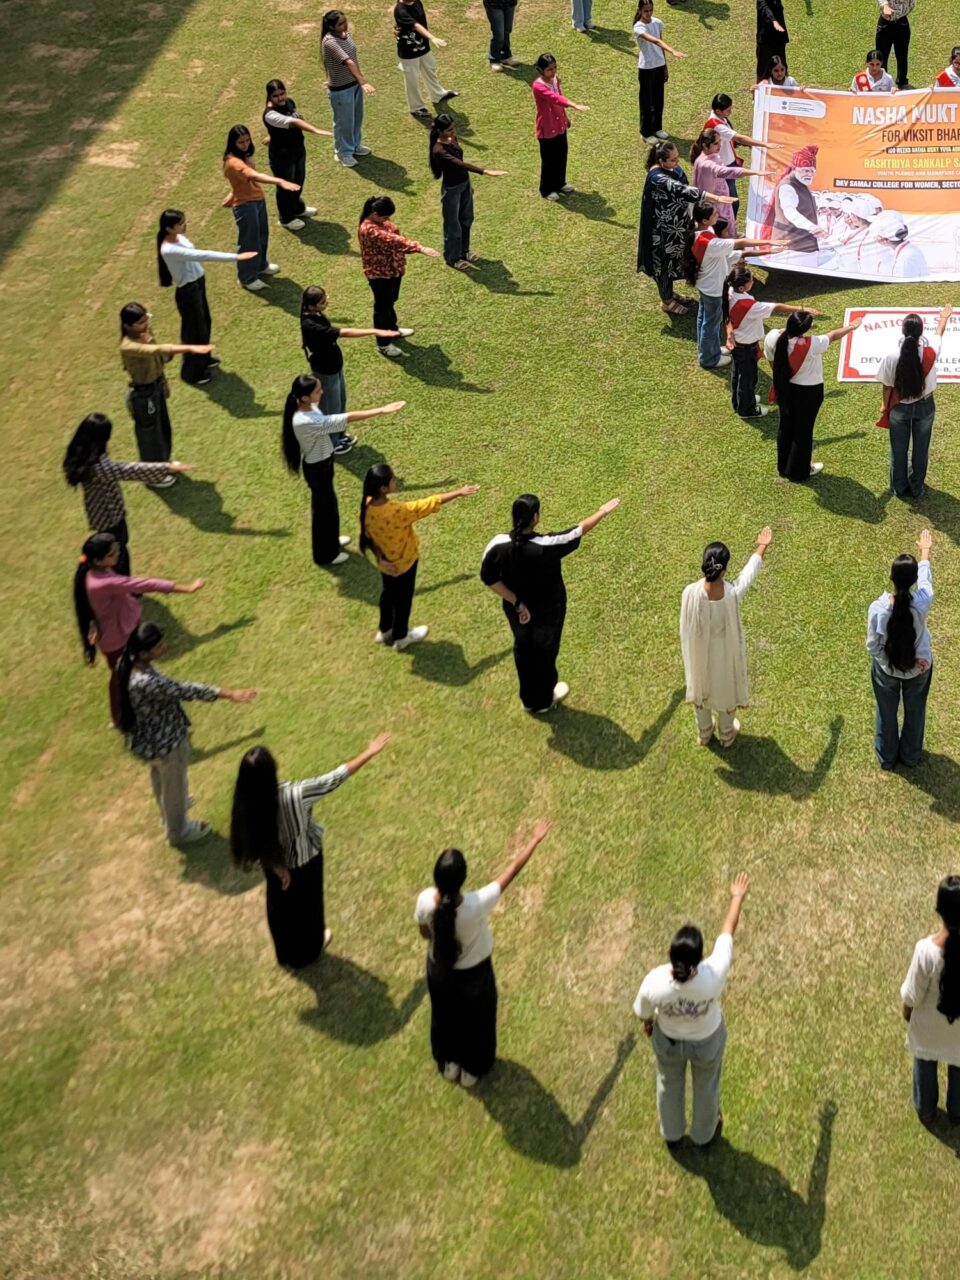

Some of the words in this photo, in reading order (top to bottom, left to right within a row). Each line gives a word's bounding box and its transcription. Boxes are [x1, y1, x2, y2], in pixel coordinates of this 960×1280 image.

[852, 105, 908, 126] NASHA
[911, 103, 958, 124] MUKT
[881, 129, 901, 143] FOR
[903, 128, 934, 142] VIKSIT
[864, 158, 911, 169] RASHTRIYA
[913, 158, 951, 169] SANKALP
[835, 179, 849, 187] DEV
[849, 180, 872, 188] SAMAJ
[872, 180, 900, 189] COLLEGE
[901, 181, 913, 189] FOR
[914, 181, 941, 190] WOMEN,
[864, 316, 931, 332] NATIOL
[860, 356, 882, 364] DEV
